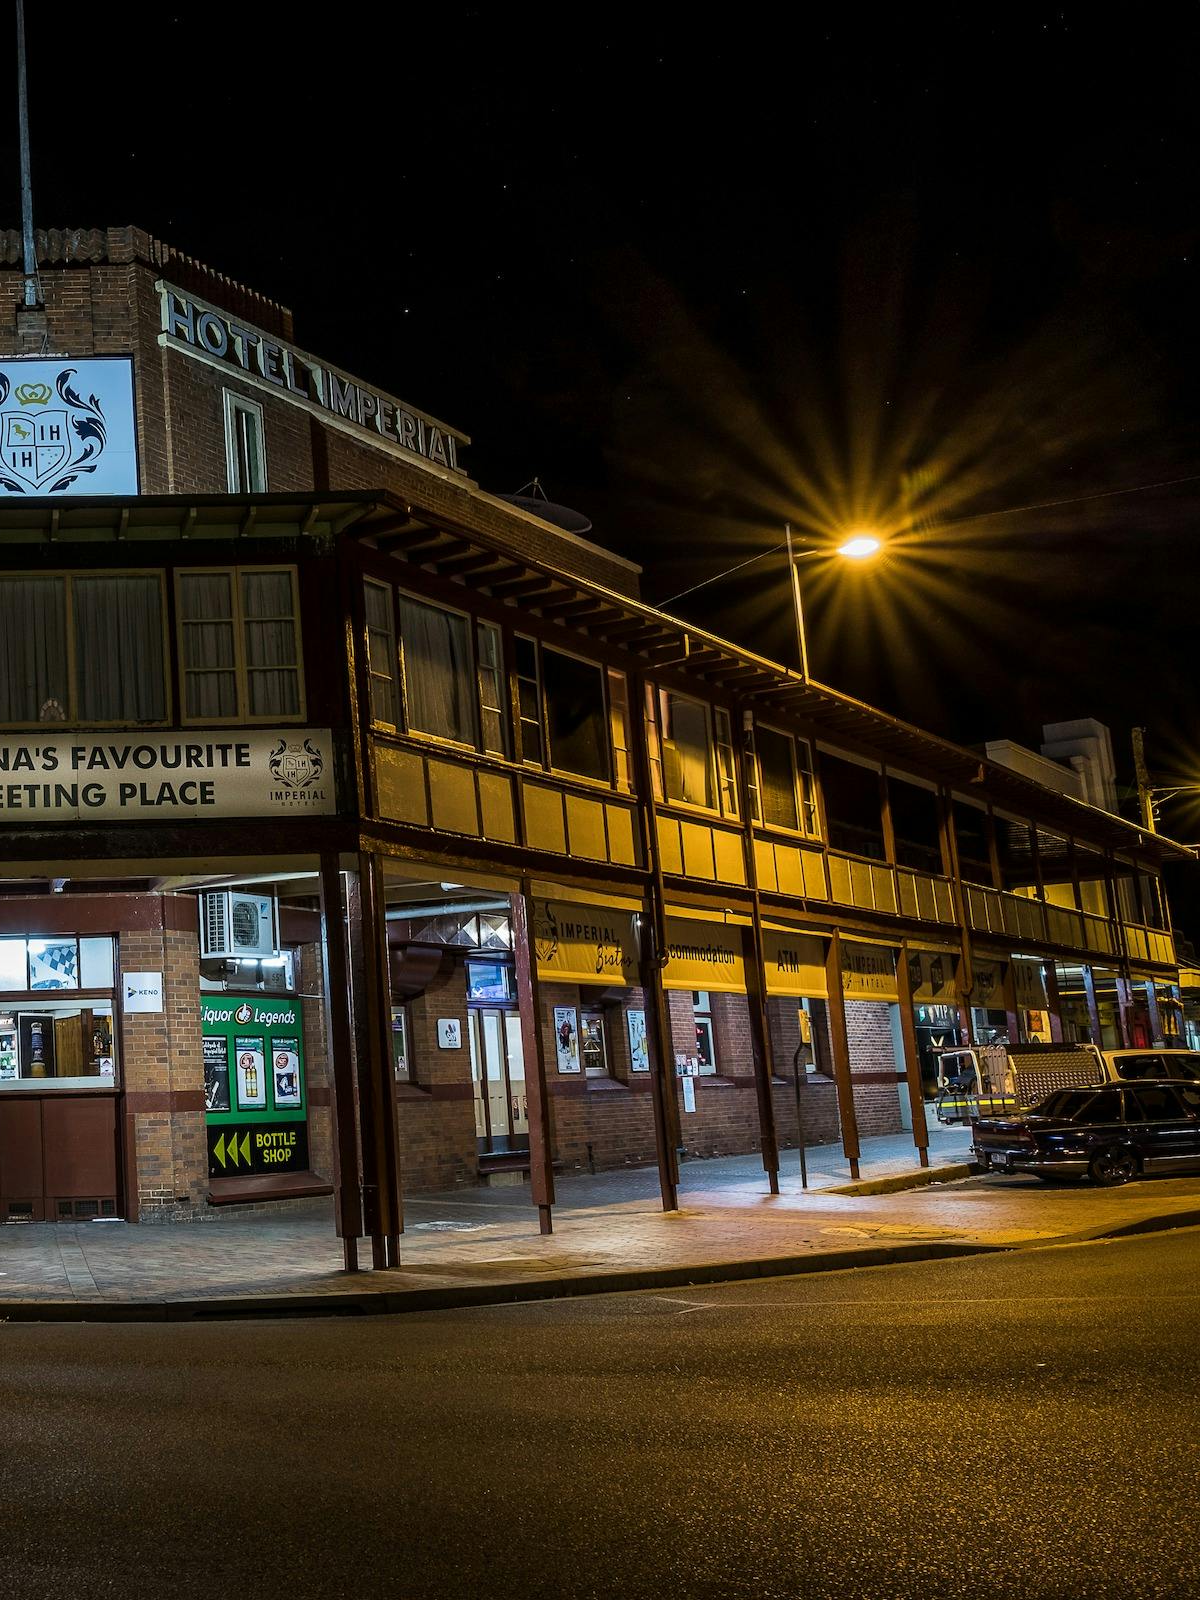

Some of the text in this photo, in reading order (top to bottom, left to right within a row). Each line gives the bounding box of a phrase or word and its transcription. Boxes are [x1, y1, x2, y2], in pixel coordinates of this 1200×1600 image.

[166, 293, 467, 476] HOTEL IMPERIAL
[41, 425, 60, 440] IH
[13, 452, 32, 467] IH
[71, 743, 250, 770] FAVOURITE
[119, 781, 215, 806] PLACE
[270, 791, 326, 800] IMPERIAL
[560, 923, 617, 943] IMPERIAL
[596, 940, 633, 973] Bistro
[668, 944, 735, 965] commodation
[777, 950, 800, 973] ATM
[254, 1008, 296, 1027] Legends
[256, 1132, 297, 1147] BOTTLE
[263, 1149, 292, 1163] SHOP
